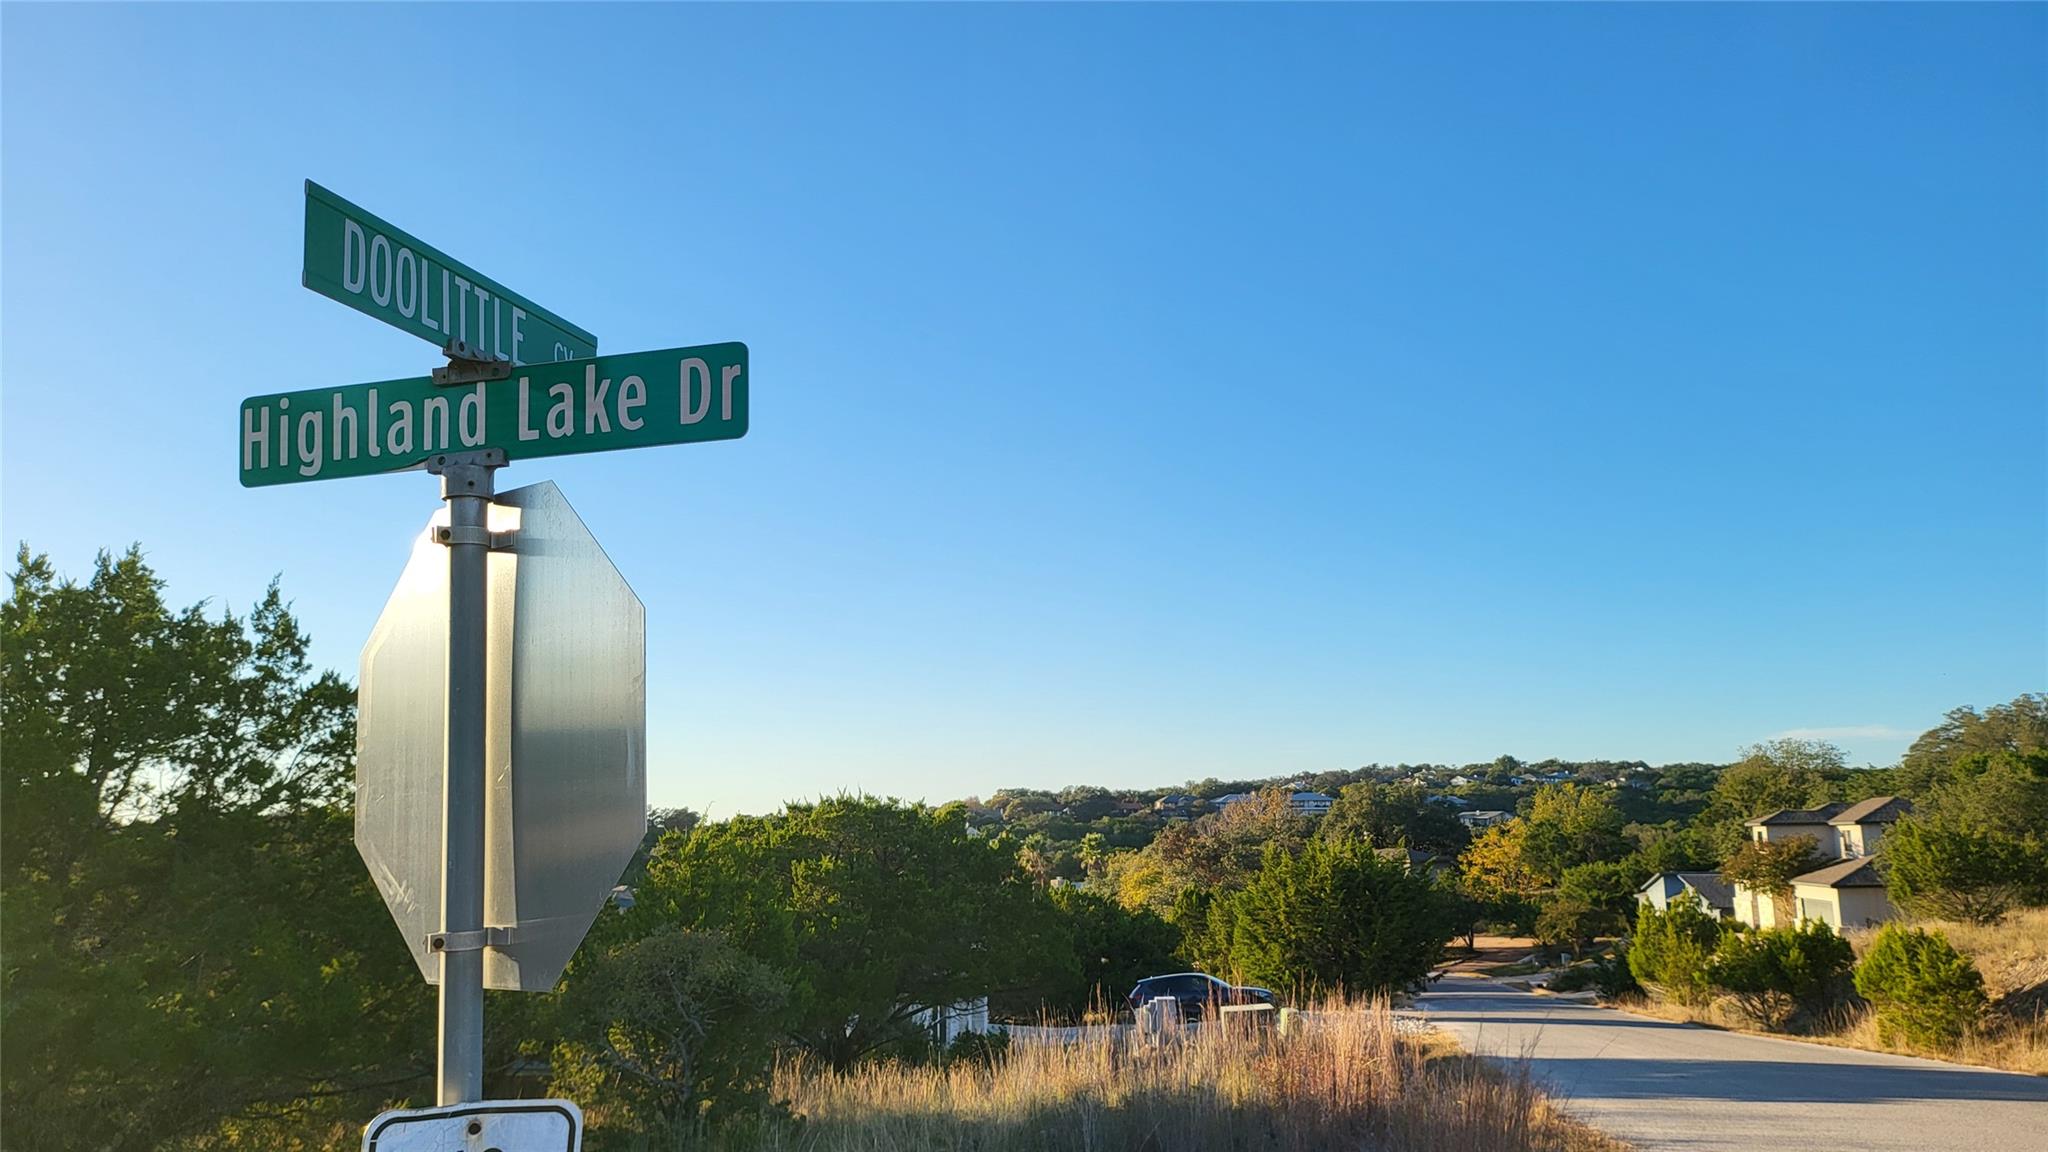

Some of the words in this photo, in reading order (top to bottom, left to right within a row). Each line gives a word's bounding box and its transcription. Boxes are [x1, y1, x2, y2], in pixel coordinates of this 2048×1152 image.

[343, 218, 527, 366] DOOLITTLE
[244, 382, 486, 477] Highland
[518, 364, 647, 441] Lake
[680, 357, 741, 425] Dr
